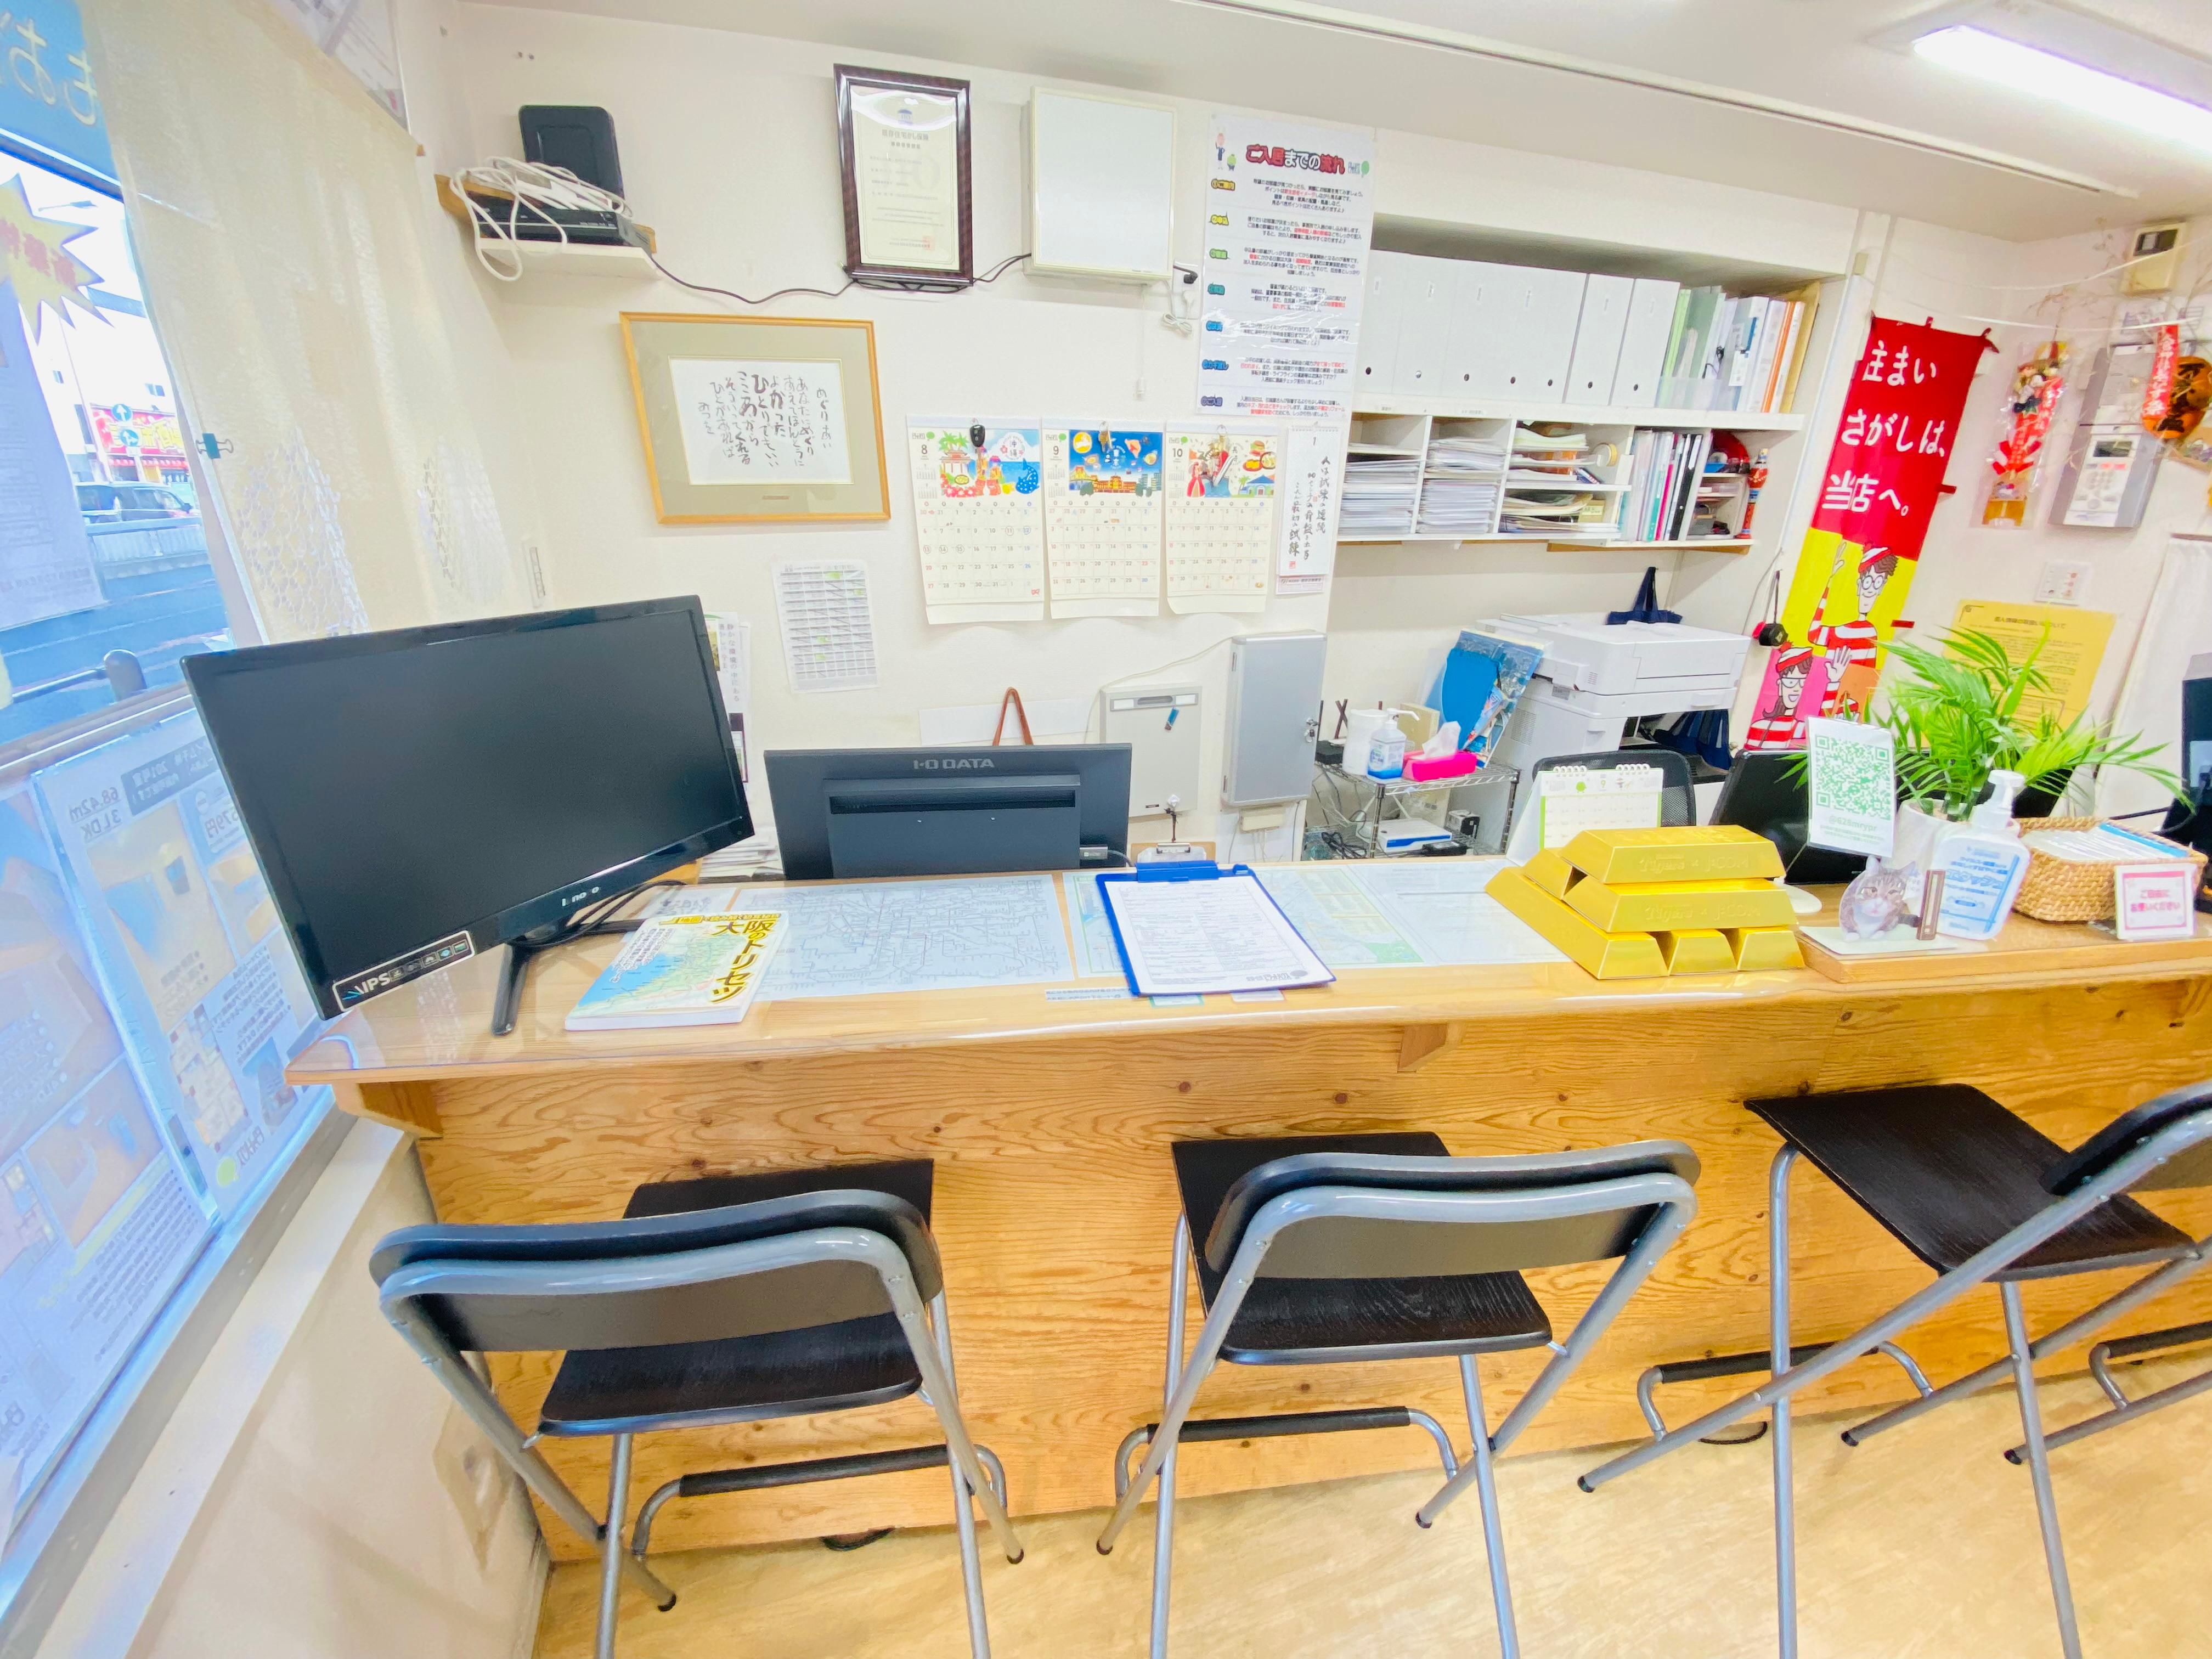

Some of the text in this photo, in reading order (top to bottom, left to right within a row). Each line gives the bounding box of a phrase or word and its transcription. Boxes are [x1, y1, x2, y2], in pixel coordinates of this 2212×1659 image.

[1246, 144, 1345, 174] ご入居までの流れ
[1862, 340, 1937, 386] 住まい
[752, 374, 779, 467] ひとりでもいい
[769, 376, 786, 437] よかった
[796, 376, 814, 455] あなたにめぐり
[817, 387, 831, 448] めぐりあい
[921, 444, 928, 454] 8
[1053, 445, 1059, 455] 9
[1172, 448, 1183, 457] 10
[1841, 408, 1945, 457] さがしは、
[1822, 470, 1909, 516] 当店へ。
[943, 758, 995, 769] DATA
